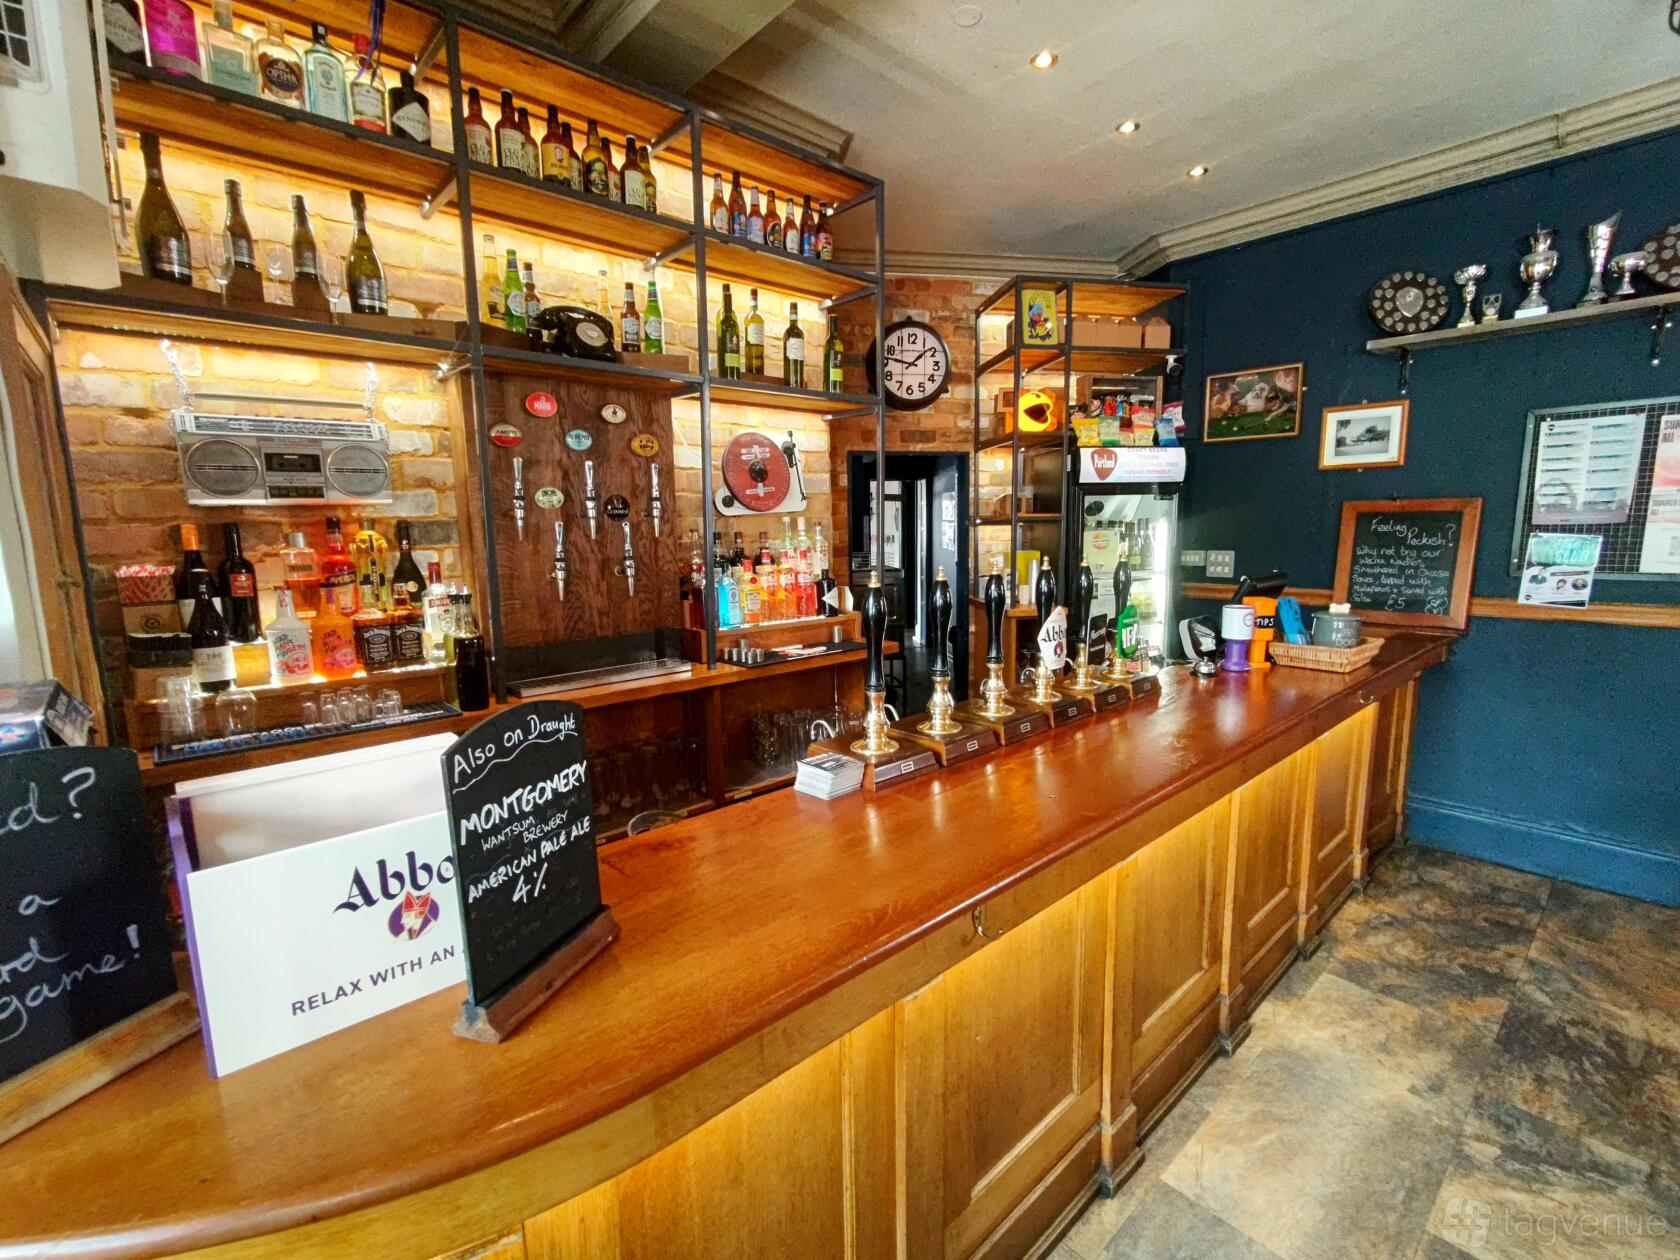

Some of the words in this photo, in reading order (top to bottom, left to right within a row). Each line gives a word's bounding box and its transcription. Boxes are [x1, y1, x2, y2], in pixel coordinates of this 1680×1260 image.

[898, 336, 903, 347] 11
[908, 333, 917, 344] 12
[923, 337, 925, 348] 1
[887, 345, 895, 356] 10
[930, 347, 936, 357] 2
[932, 361, 940, 371] 3
[885, 371, 893, 381] 8
[928, 374, 936, 384] 4
[895, 381, 903, 391] 7
[906, 385, 914, 395] 6
[918, 383, 925, 392] 5
[1370, 516, 1407, 536] Feeling
[1356, 546, 1377, 558] Why
[1381, 546, 1395, 555] not
[1401, 546, 1417, 557] try
[1421, 550, 1441, 558] our
[453, 744, 495, 784] Also
[504, 728, 523, 747] on
[527, 712, 576, 741] Draught
[460, 760, 587, 846] MONTGOMERY
[523, 810, 568, 844] BREWERY
[481, 815, 536, 851] WANTSUM
[468, 849, 537, 903] AMERICAN
[541, 830, 567, 858] PALE
[570, 816, 591, 841] ALE
[512, 862, 548, 904] 4%
[19, 894, 62, 916] a
[291, 978, 363, 1016] RELAX
[369, 957, 423, 987] WITH
[430, 945, 455, 965] AN
